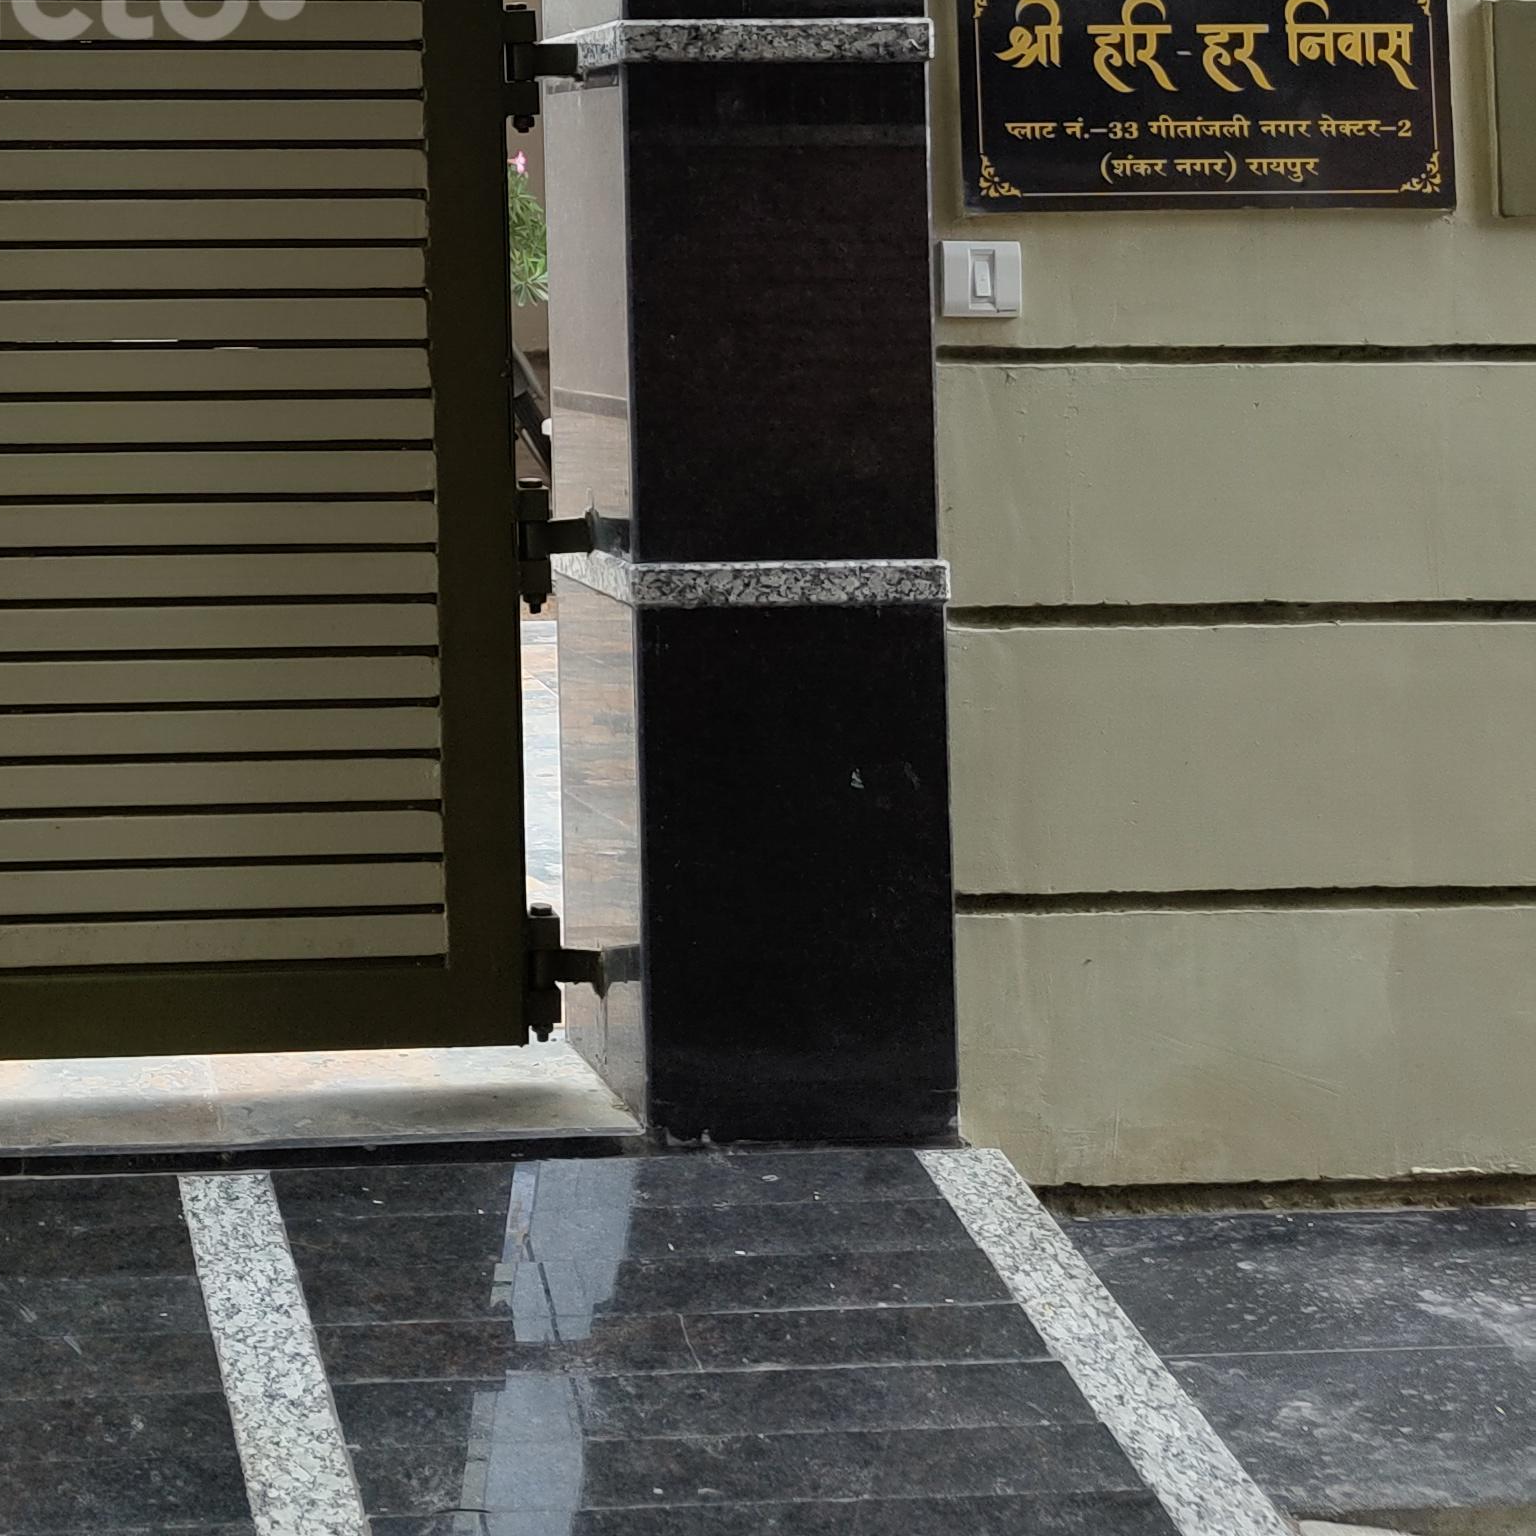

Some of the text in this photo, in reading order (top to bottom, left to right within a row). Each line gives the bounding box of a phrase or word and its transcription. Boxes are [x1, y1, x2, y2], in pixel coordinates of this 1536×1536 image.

[1004, 121, 1058, 141] प्लाट
[1147, 114, 1251, 140] गीतांजली
[1258, 119, 1312, 139] नगर
[1317, 113, 1413, 139] सेक्टर-2
[1100, 150, 1320, 185] (शंकर नगर) रायपुर
